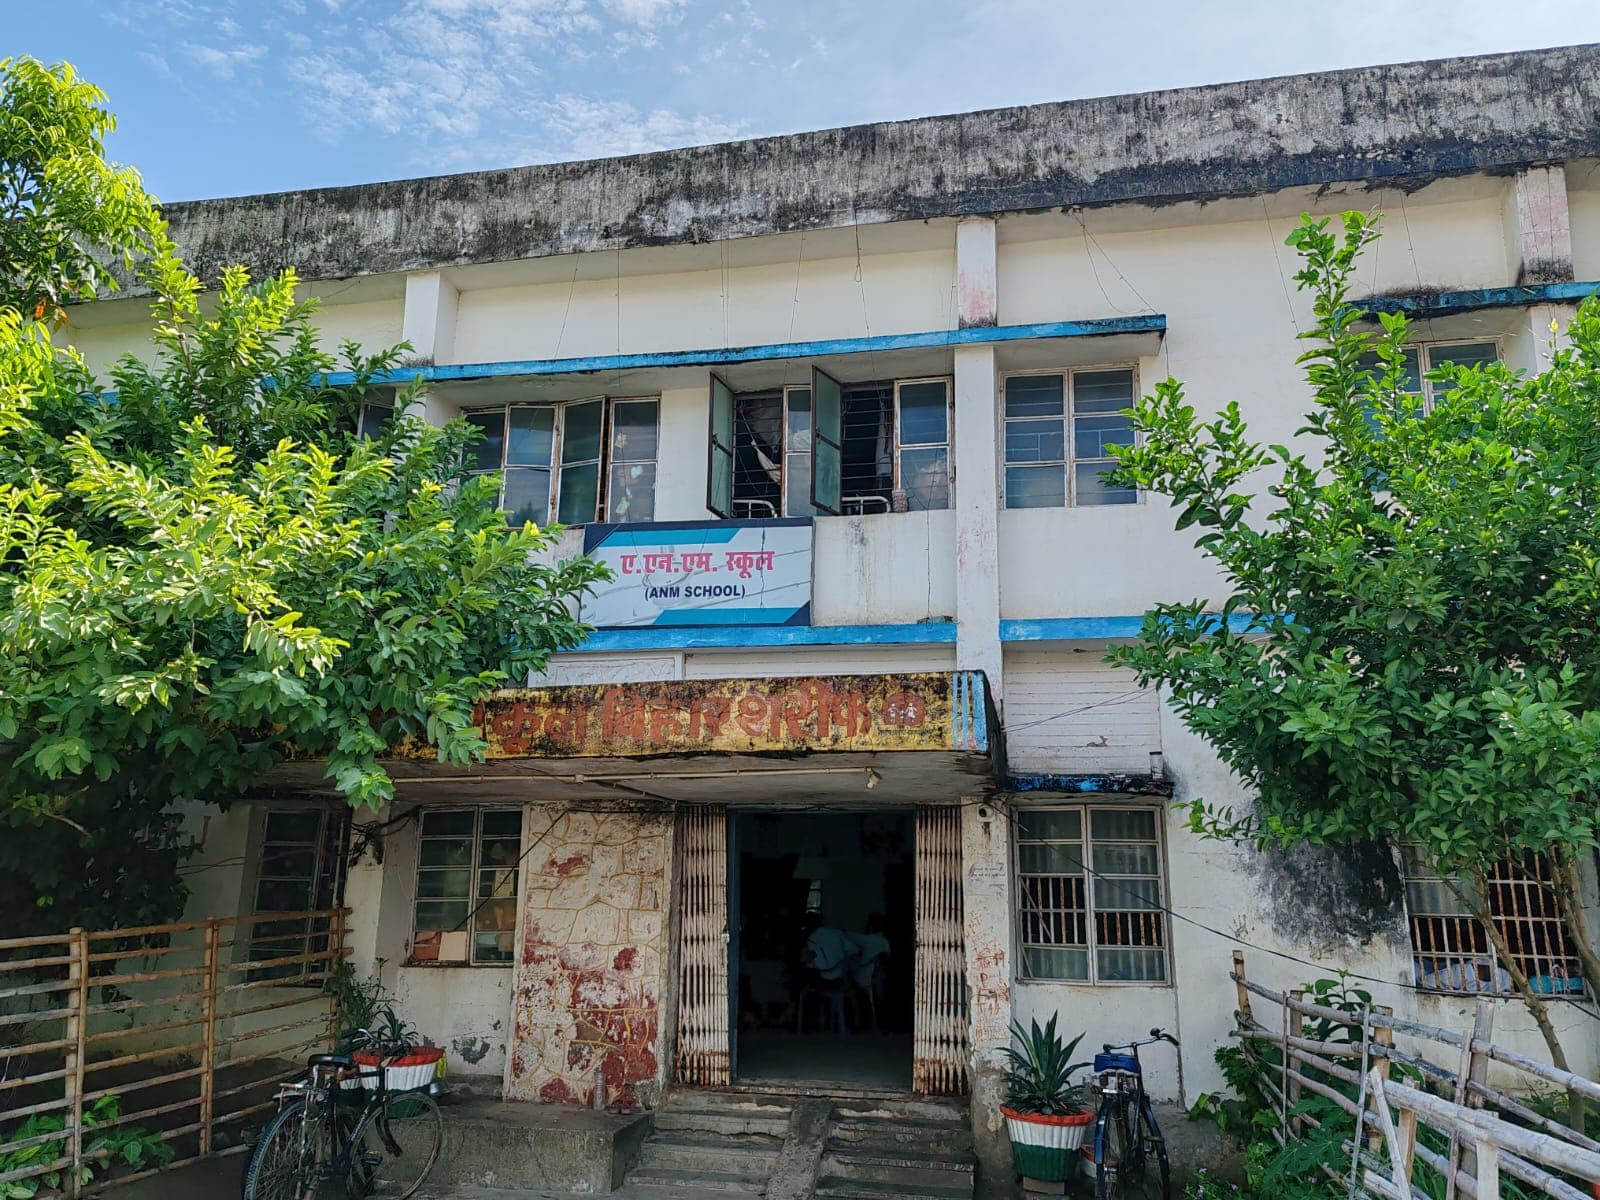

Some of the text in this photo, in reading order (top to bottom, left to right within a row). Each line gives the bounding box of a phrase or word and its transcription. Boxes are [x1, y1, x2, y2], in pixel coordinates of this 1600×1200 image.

[620, 550, 775, 579] ए.एन.एम. स्कूल
[644, 584, 746, 602] (ANM SCHOOL)
